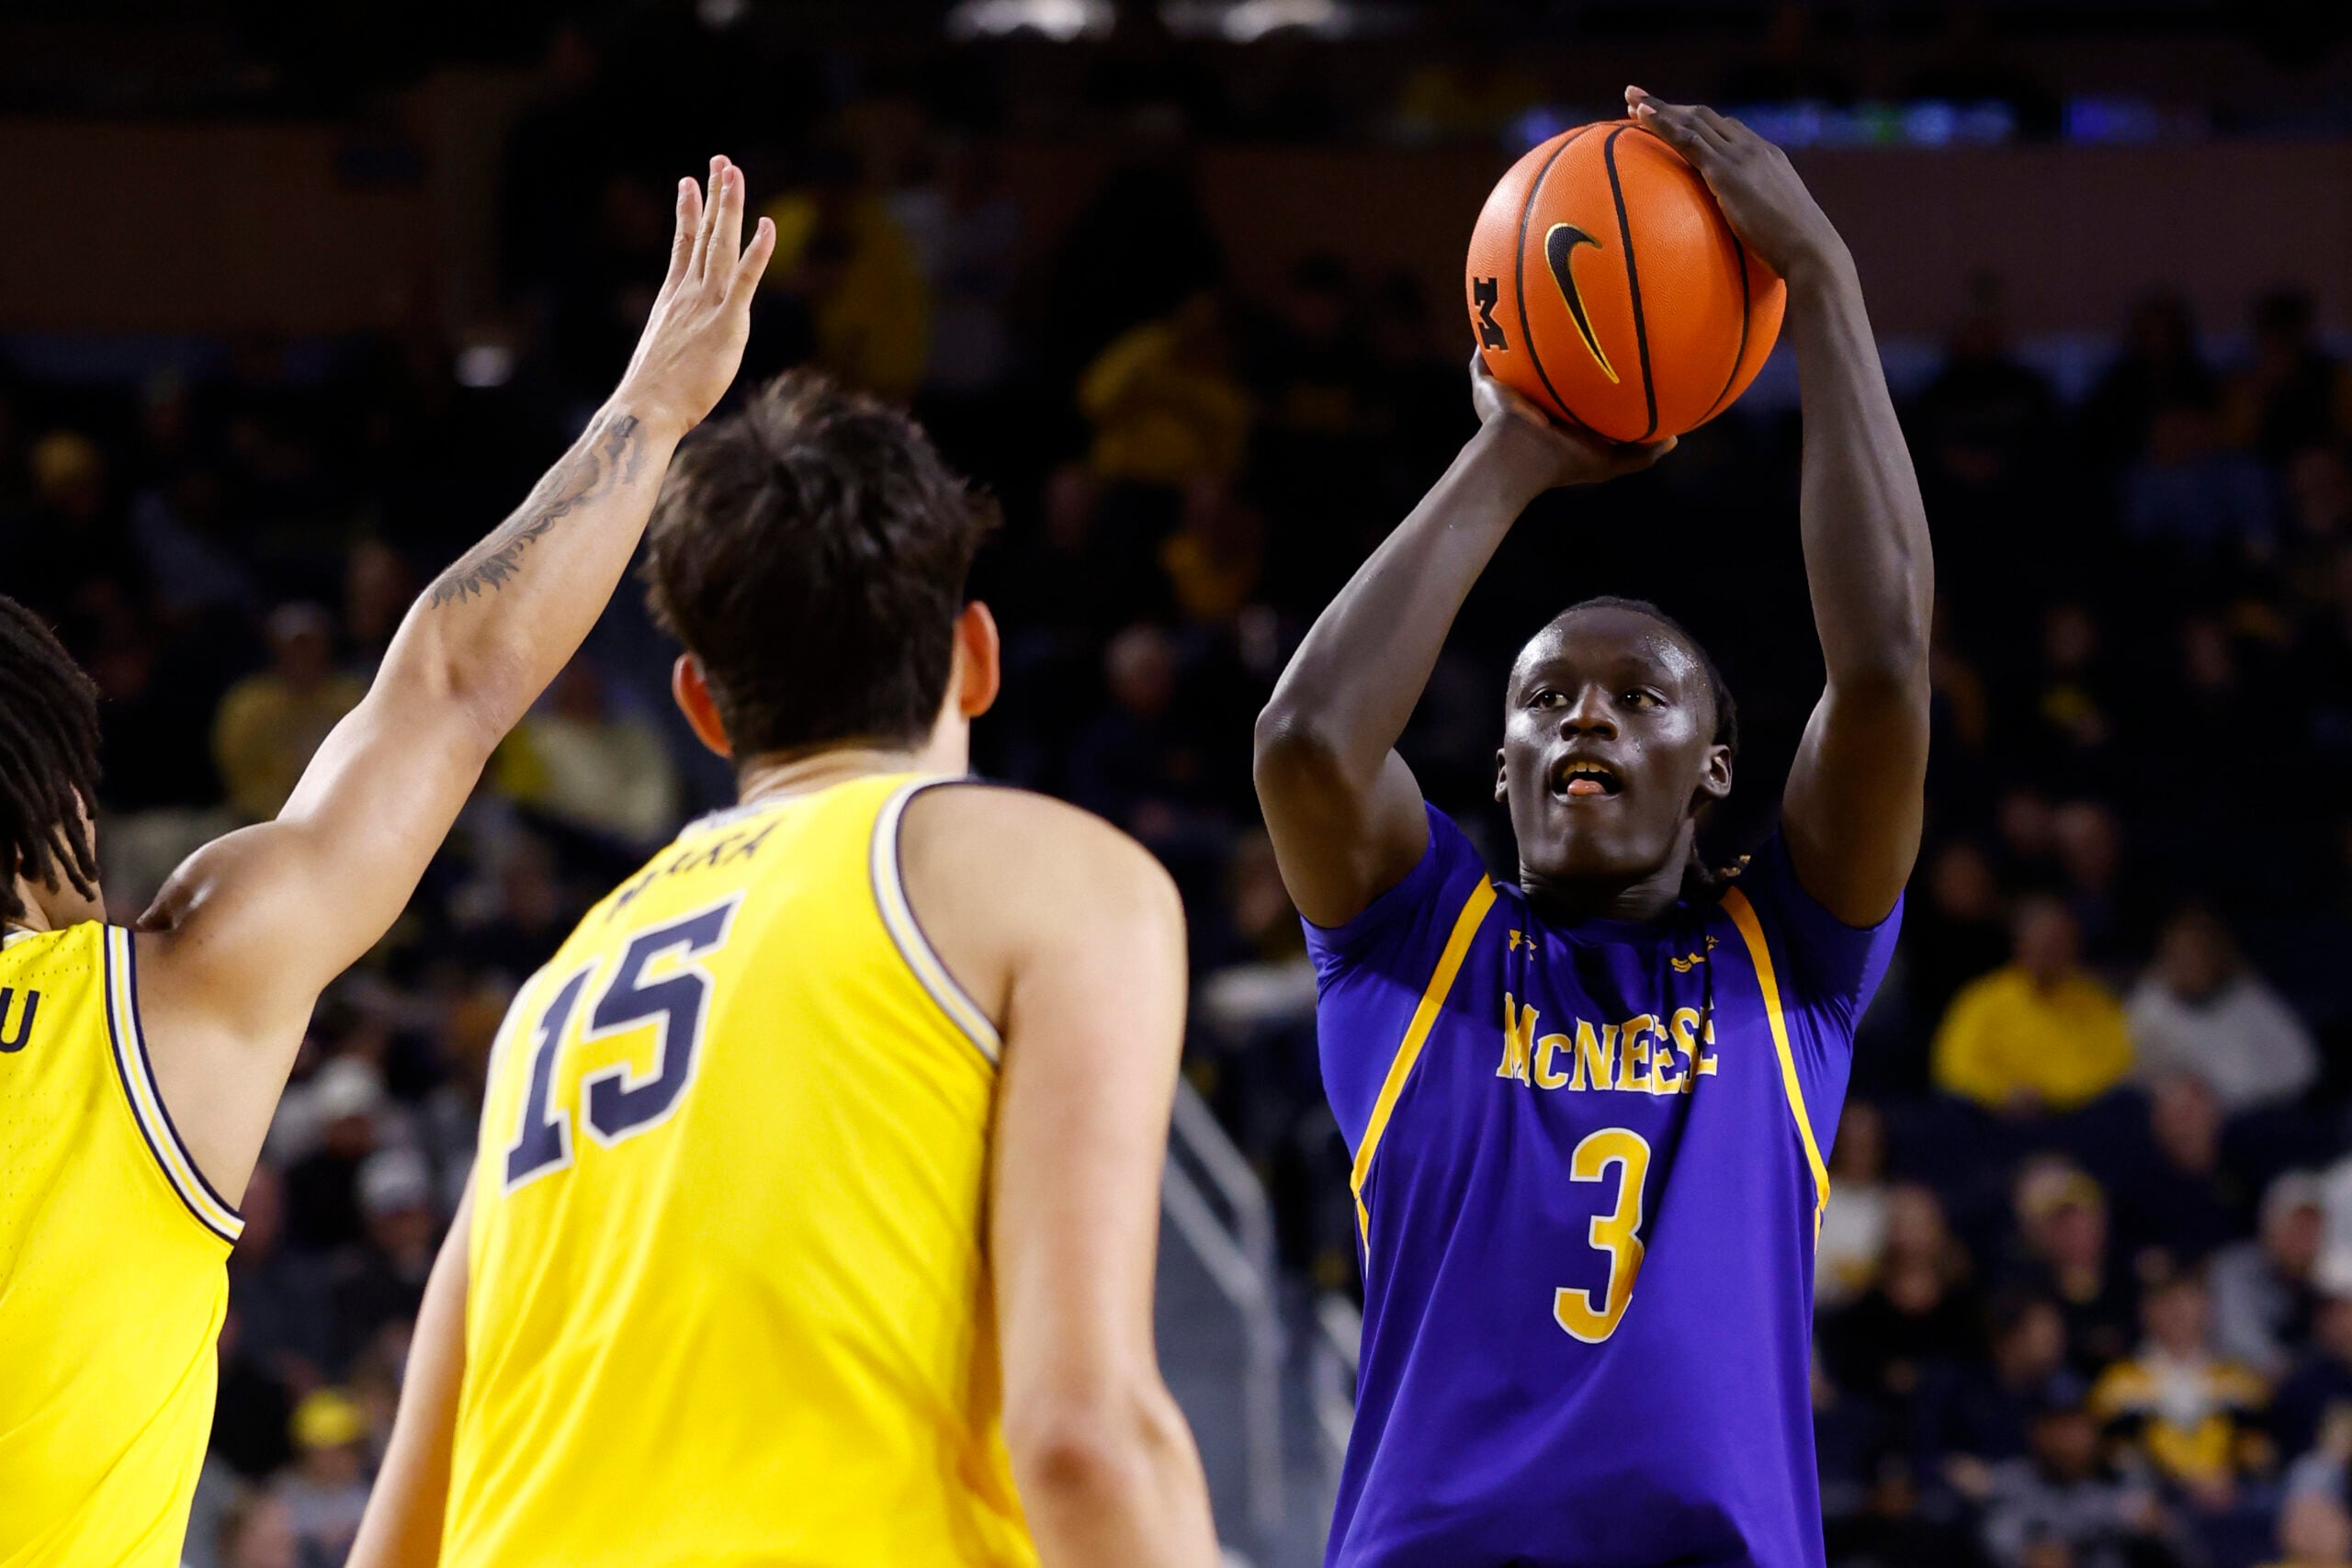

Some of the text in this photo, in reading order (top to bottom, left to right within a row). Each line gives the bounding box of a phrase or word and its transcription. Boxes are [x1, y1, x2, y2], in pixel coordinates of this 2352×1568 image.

[503, 887, 746, 1198] 15
[1495, 991, 1718, 1096] McNEESE
[1553, 1127, 1651, 1344] 3
